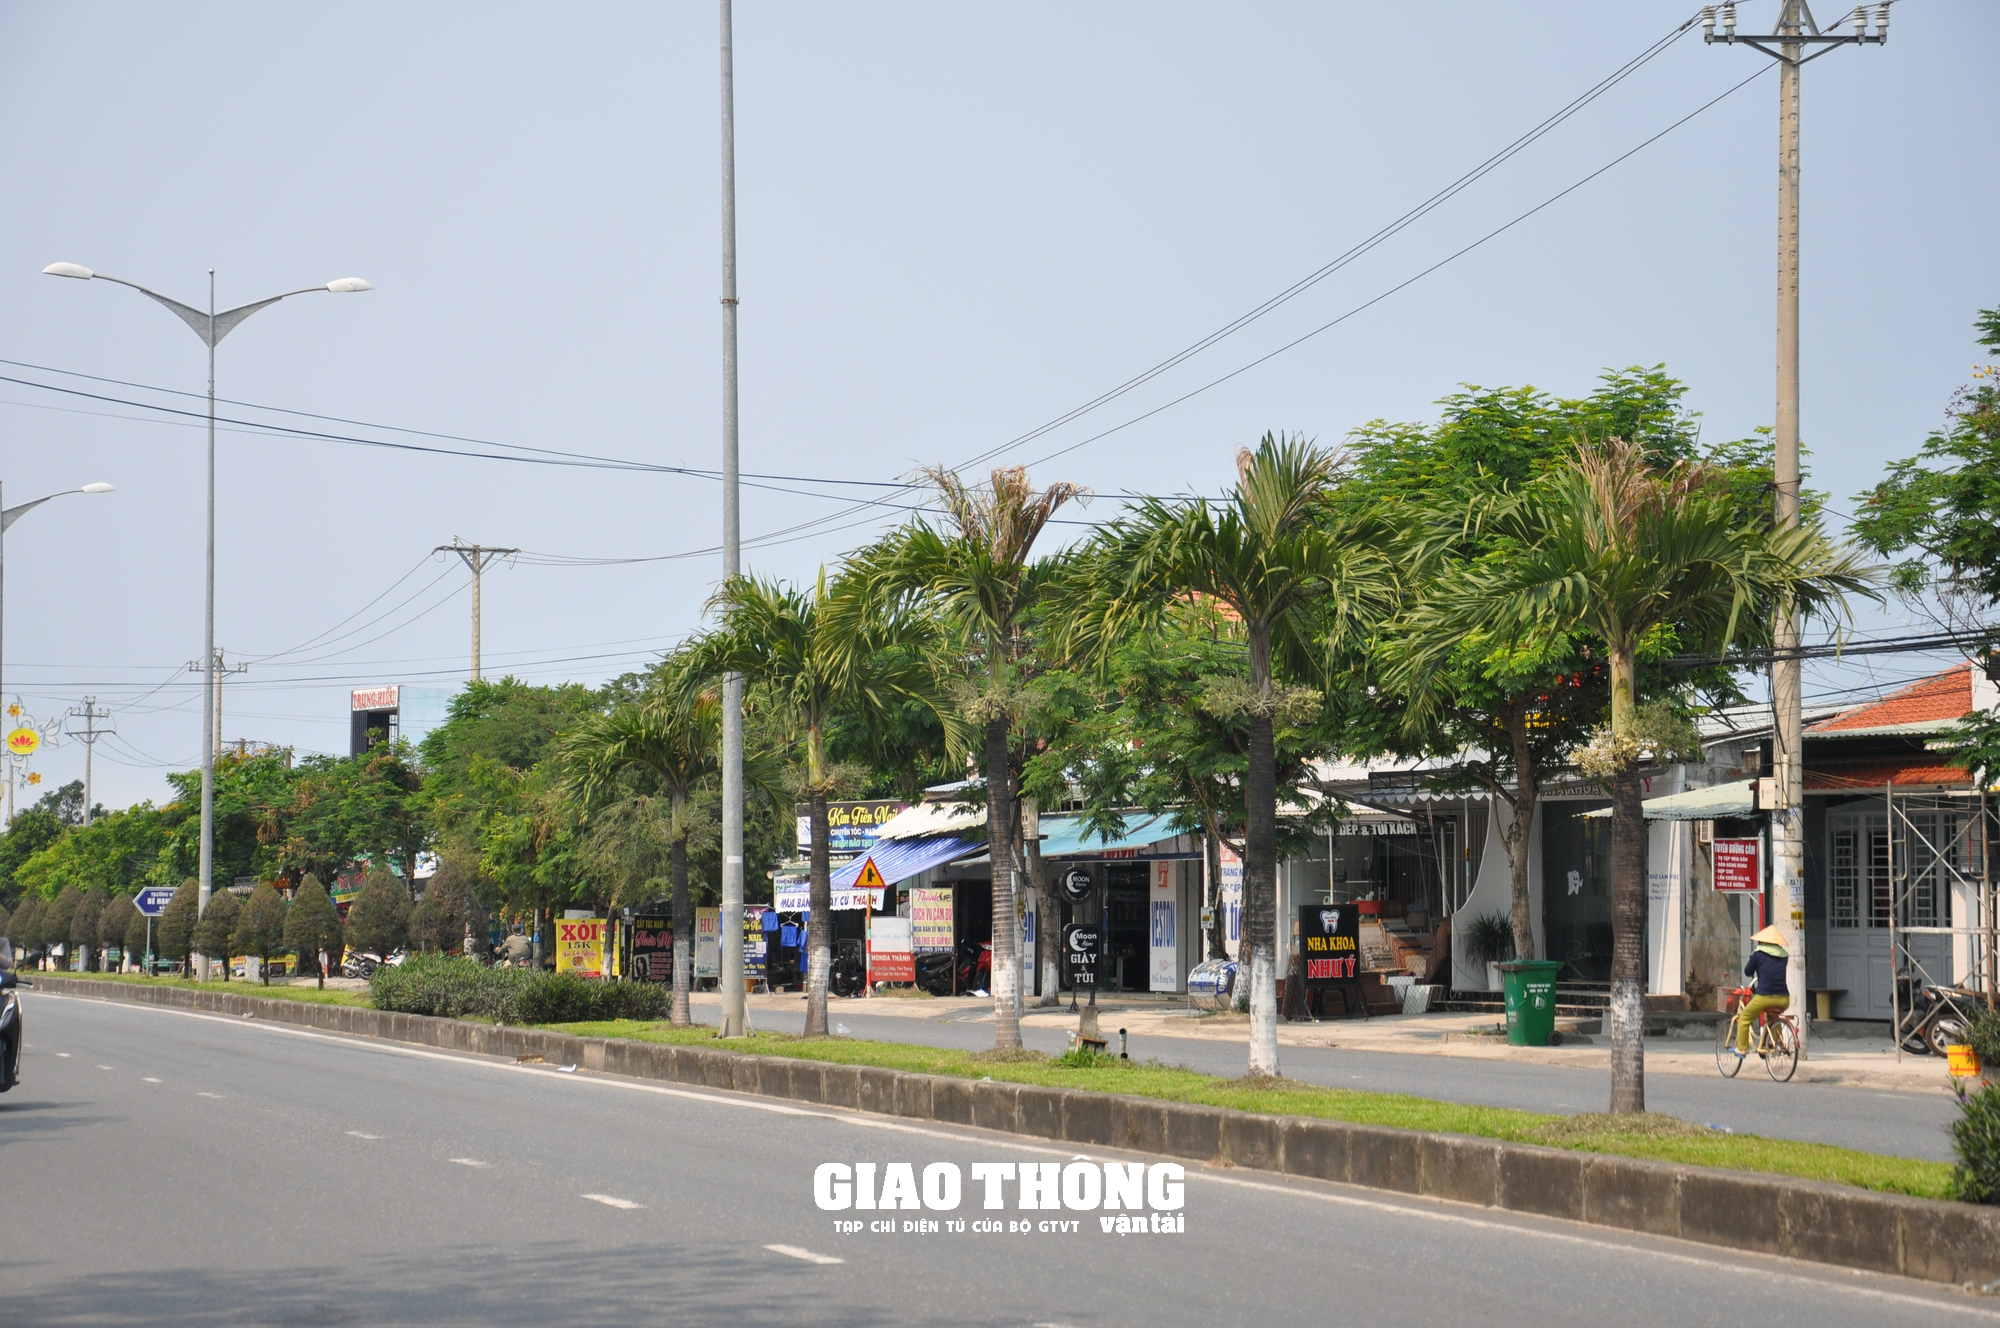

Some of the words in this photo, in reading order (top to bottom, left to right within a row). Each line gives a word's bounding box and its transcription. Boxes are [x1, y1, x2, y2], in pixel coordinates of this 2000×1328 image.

[353, 692, 376, 708] TRUNG
[828, 807, 850, 826] Kim
[851, 805, 873, 826] Tiến
[851, 826, 862, 835] TÓC
[1389, 820, 1418, 835] XÁCH
[780, 898, 795, 908] MUA
[853, 892, 878, 905] THÀH
[699, 911, 714, 933] HỦ
[560, 920, 598, 941] XÔI
[1076, 931, 1098, 940] Moon
[568, 941, 591, 949] 15K
[748, 934, 763, 942] NAIL
[1307, 937, 1328, 951] NHA
[1329, 936, 1356, 951] KHOA
[892, 954, 910, 962] THÀNH
[1071, 951, 1097, 964] GIÀY
[1081, 964, 1087, 972] &
[1307, 957, 1345, 979] NHƯ
[1345, 954, 1356, 979] Ý
[1074, 970, 1095, 984] TÚI
